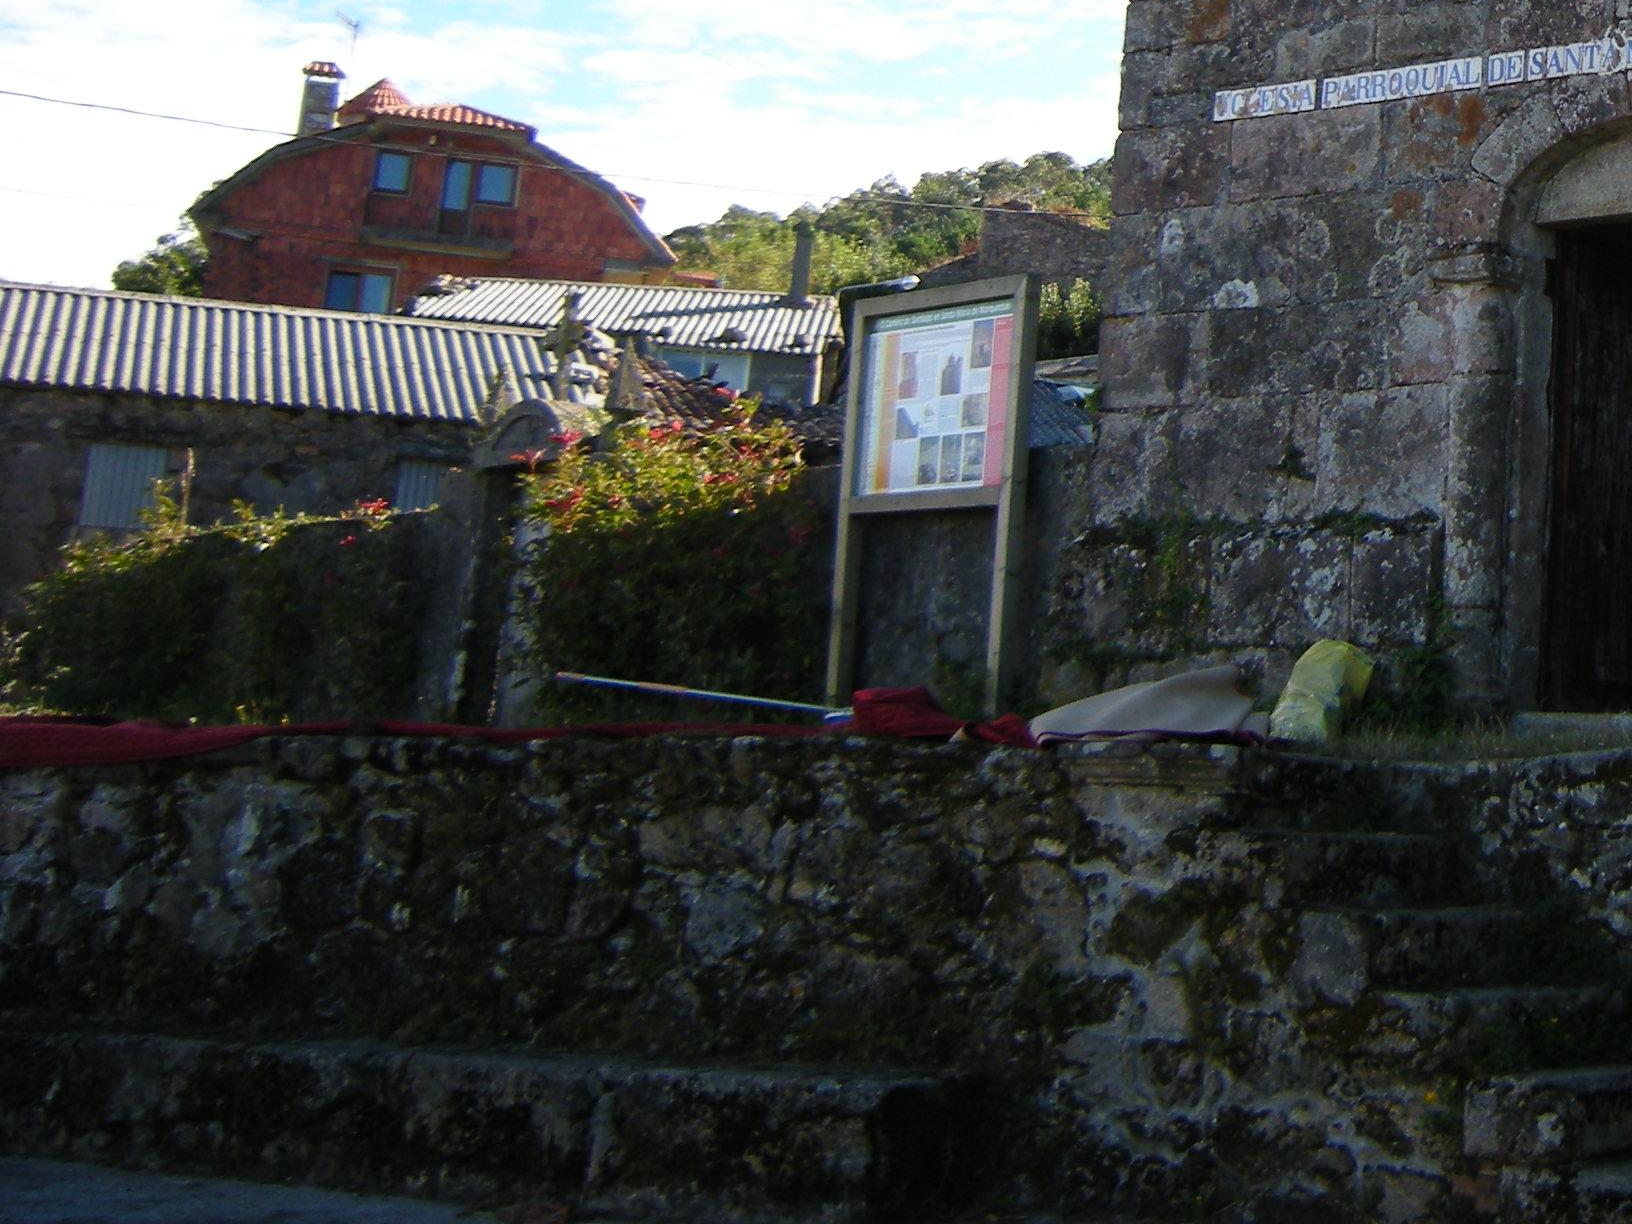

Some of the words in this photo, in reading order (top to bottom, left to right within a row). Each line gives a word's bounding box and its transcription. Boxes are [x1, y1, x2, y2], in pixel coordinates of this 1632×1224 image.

[1324, 60, 1481, 105] PARROQUIAL
[1489, 54, 1523, 82] DE
[1530, 41, 1619, 75] SANTA
